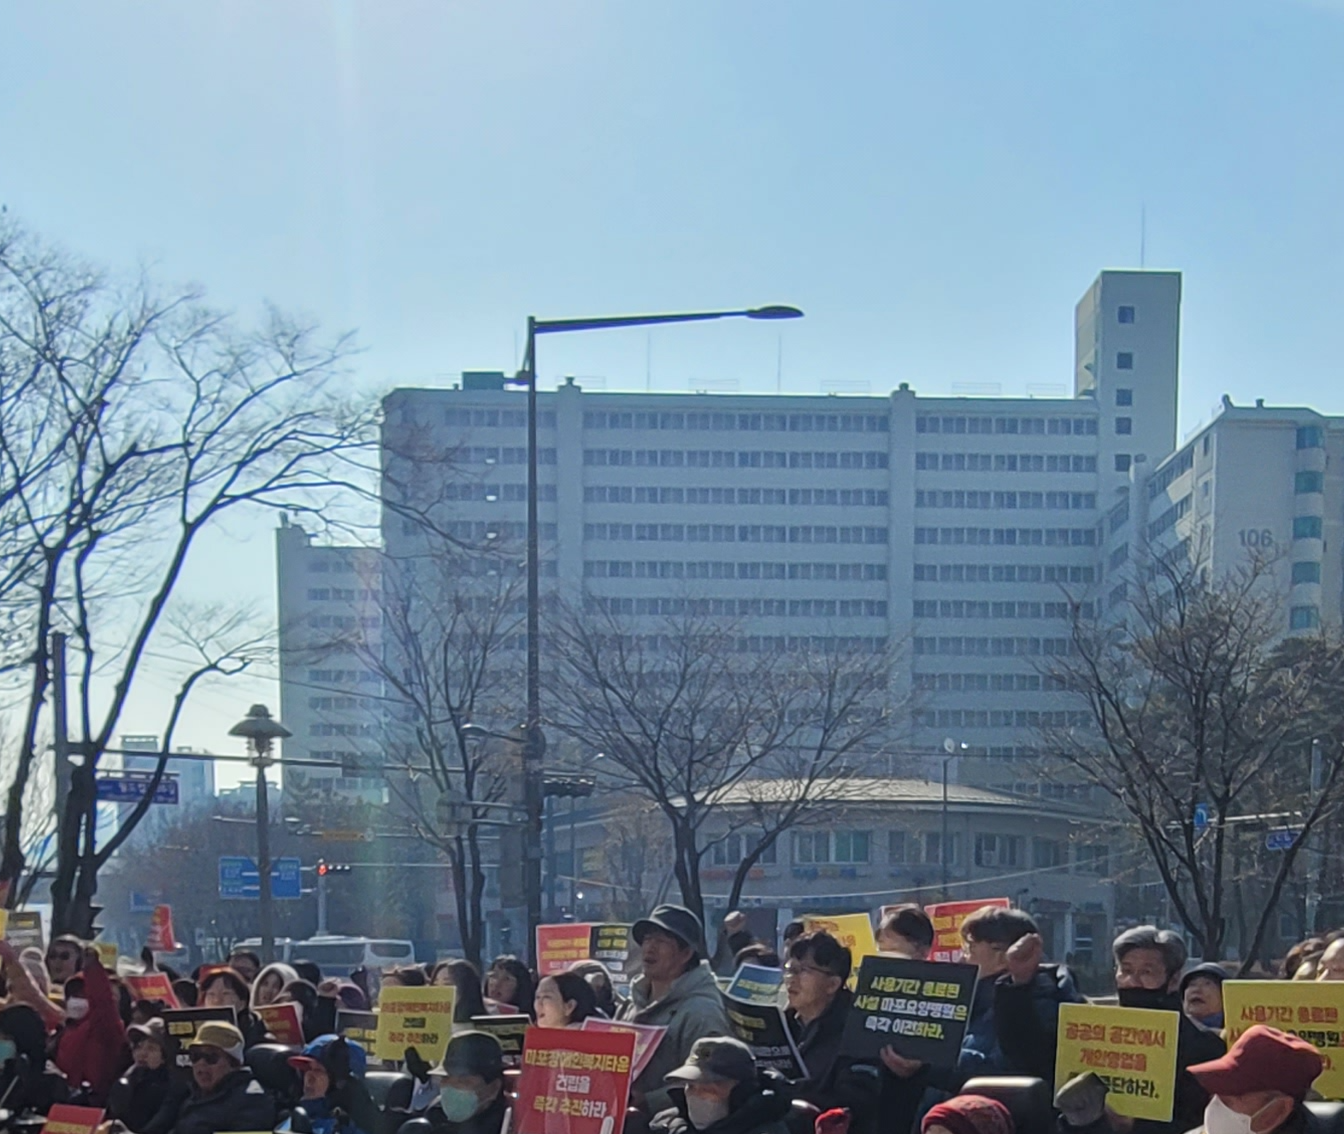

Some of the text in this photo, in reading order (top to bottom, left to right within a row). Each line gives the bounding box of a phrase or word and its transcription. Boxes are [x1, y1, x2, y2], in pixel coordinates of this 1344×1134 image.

[870, 976, 920, 995] 사용기간
[880, 997, 968, 1022] 마포요양병원은
[1240, 1005, 1293, 1022] 사용기간
[865, 1015, 891, 1032] 즉각
[387, 1030, 405, 1043] 즉각
[1110, 1025, 1166, 1049] 공간에서
[524, 1048, 630, 1073] 마포장애인복지타운
[555, 1074, 591, 1094] 건립을
[1099, 1075, 1160, 1100] 단하라.
[533, 1095, 607, 1119] 즉각 추진하라
